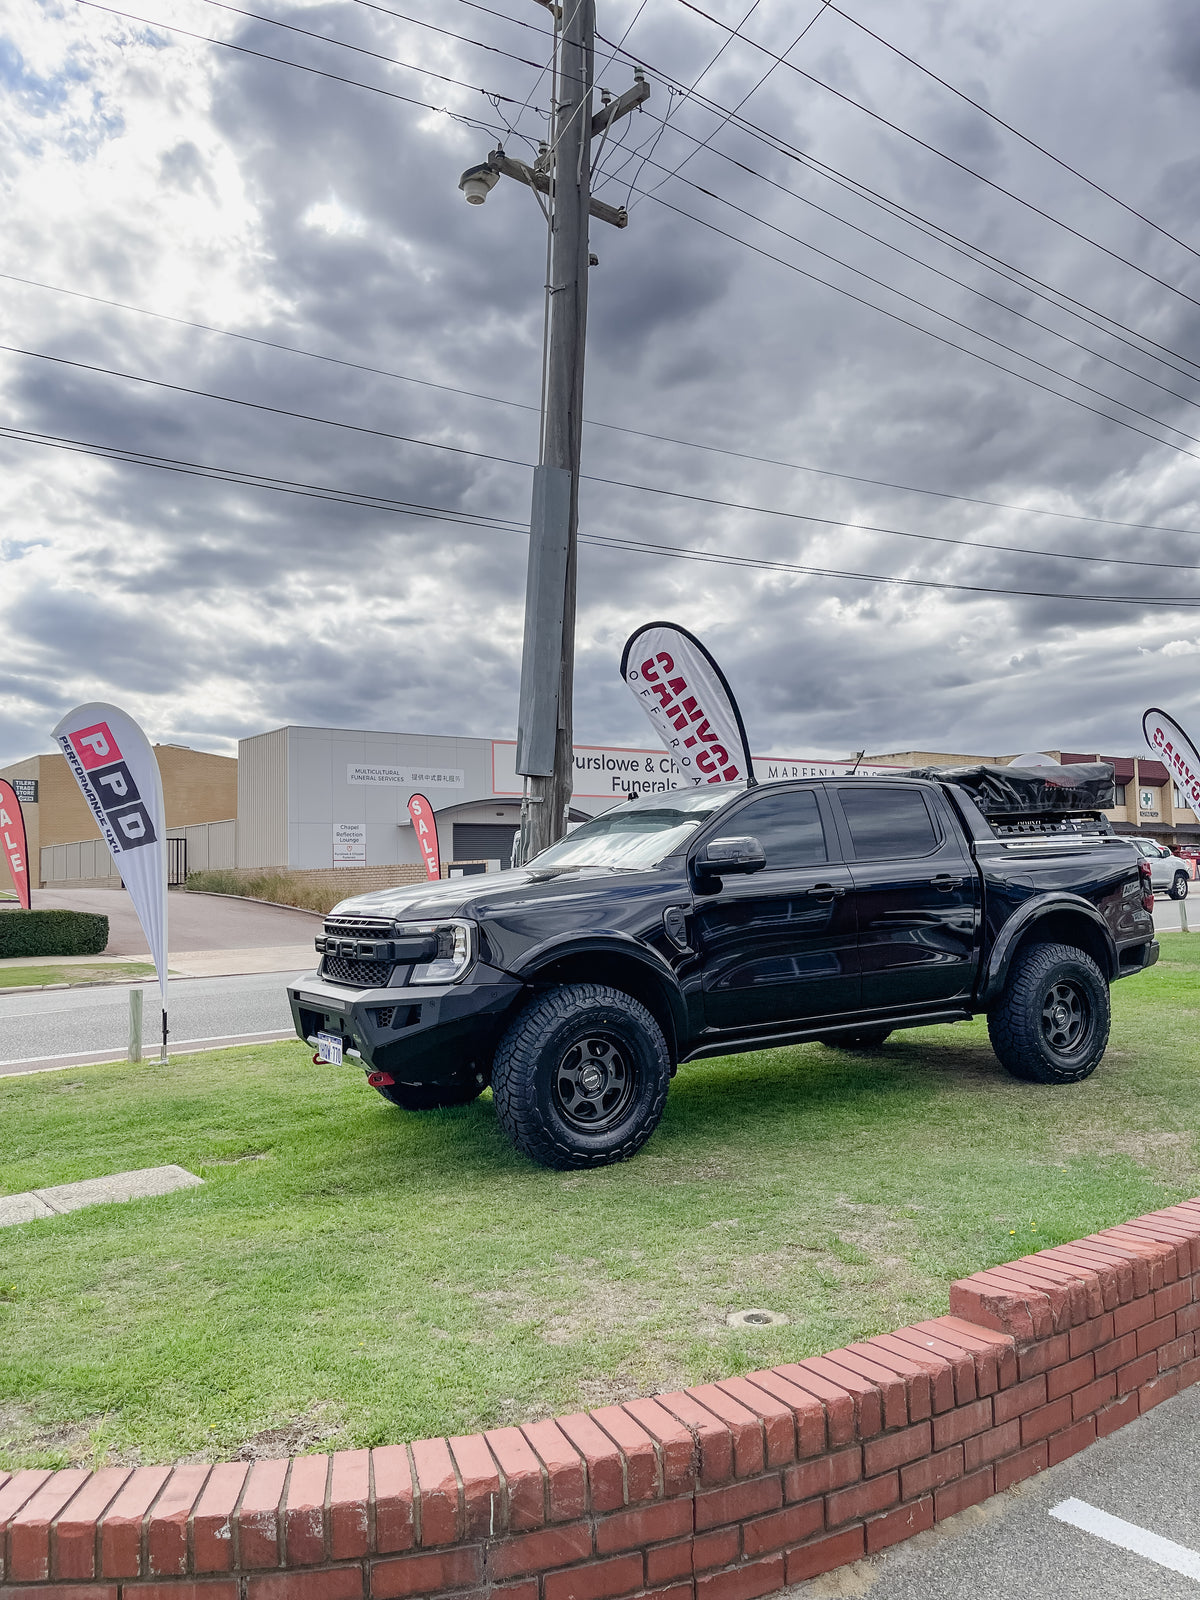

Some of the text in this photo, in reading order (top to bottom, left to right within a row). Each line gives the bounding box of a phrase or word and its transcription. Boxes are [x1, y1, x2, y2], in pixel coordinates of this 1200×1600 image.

[355, 768, 400, 776] MULTICULTURAL
[572, 754, 640, 772] urslowe
[644, 757, 655, 773] &
[59, 735, 108, 827] PERFORMANCE
[79, 731, 147, 840] PPD
[351, 774, 405, 783] FUNERAL SERVICES
[612, 776, 678, 793] Funerals
[411, 800, 438, 873] SALE
